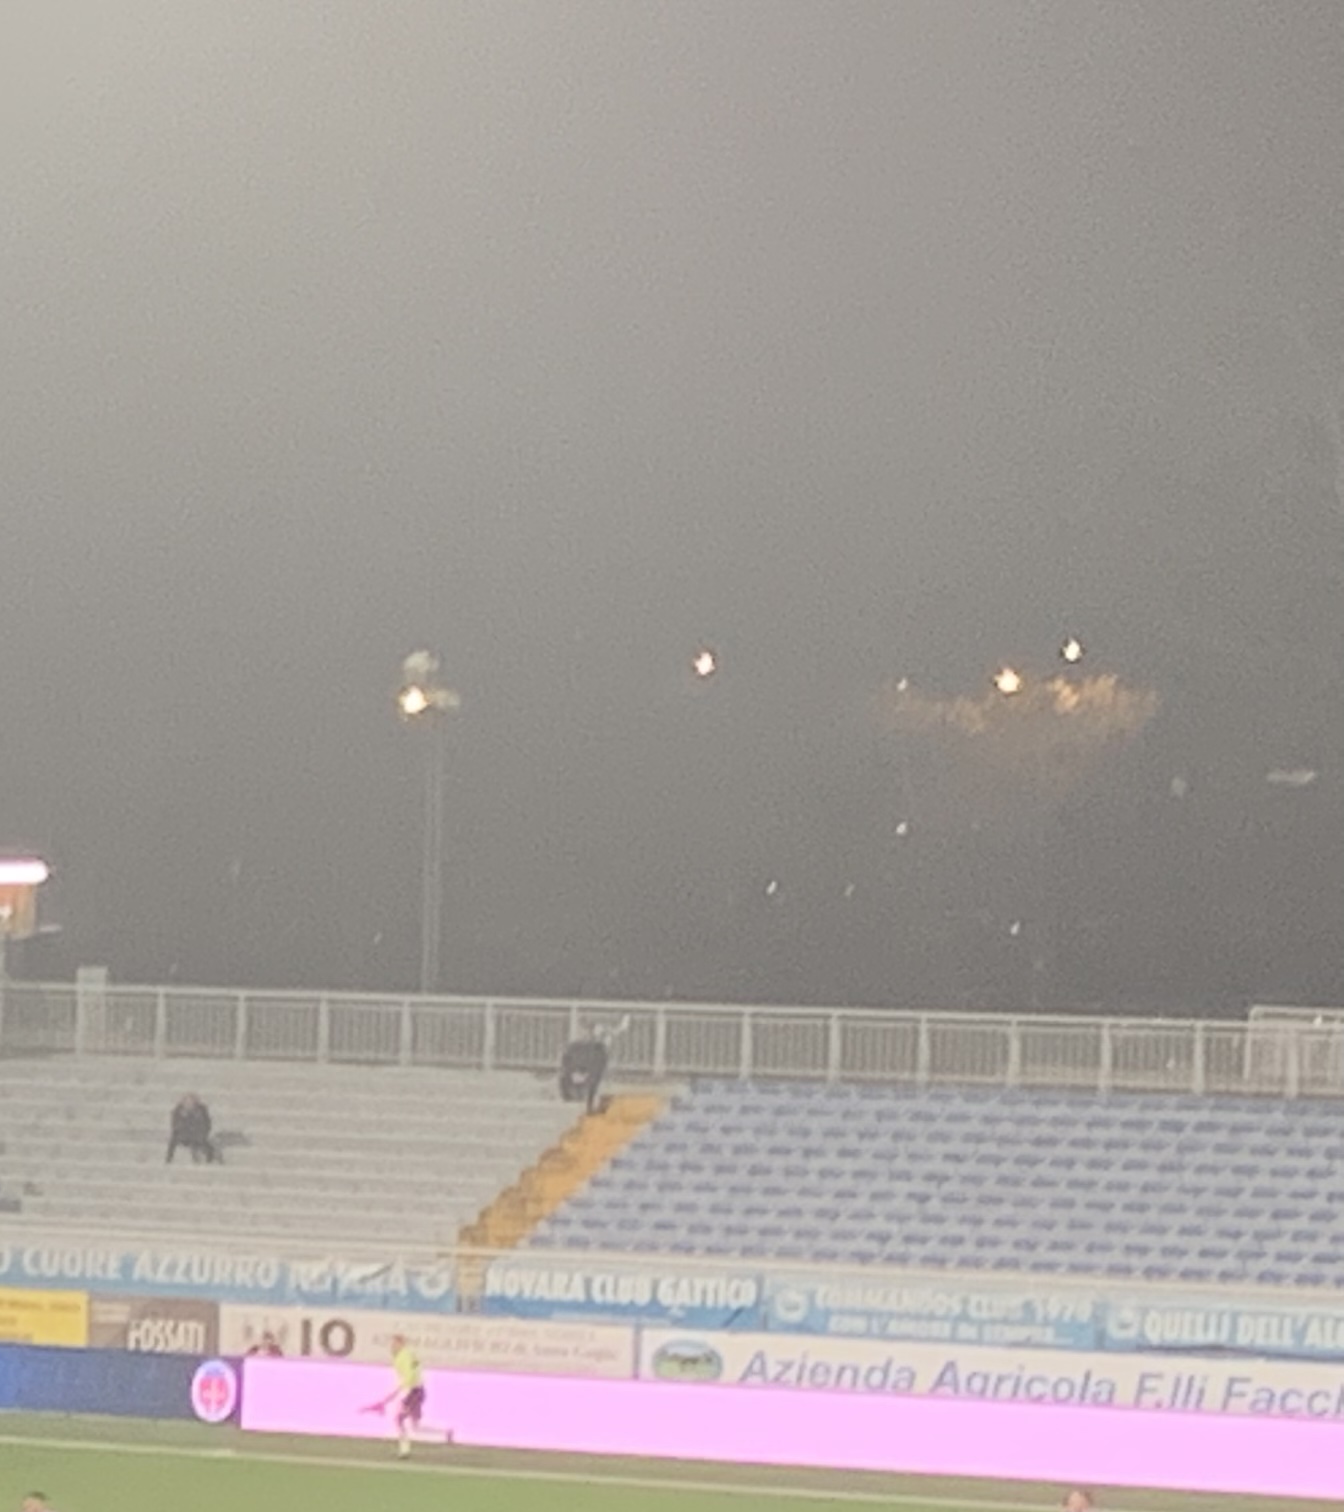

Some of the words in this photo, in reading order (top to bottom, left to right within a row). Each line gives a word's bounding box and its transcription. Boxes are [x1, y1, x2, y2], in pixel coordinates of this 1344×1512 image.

[22, 1245, 122, 1281] CUORE
[134, 1250, 280, 1290] AZZURRO
[738, 1350, 916, 1393] Azienda
[928, 1358, 1118, 1404] Agricola
